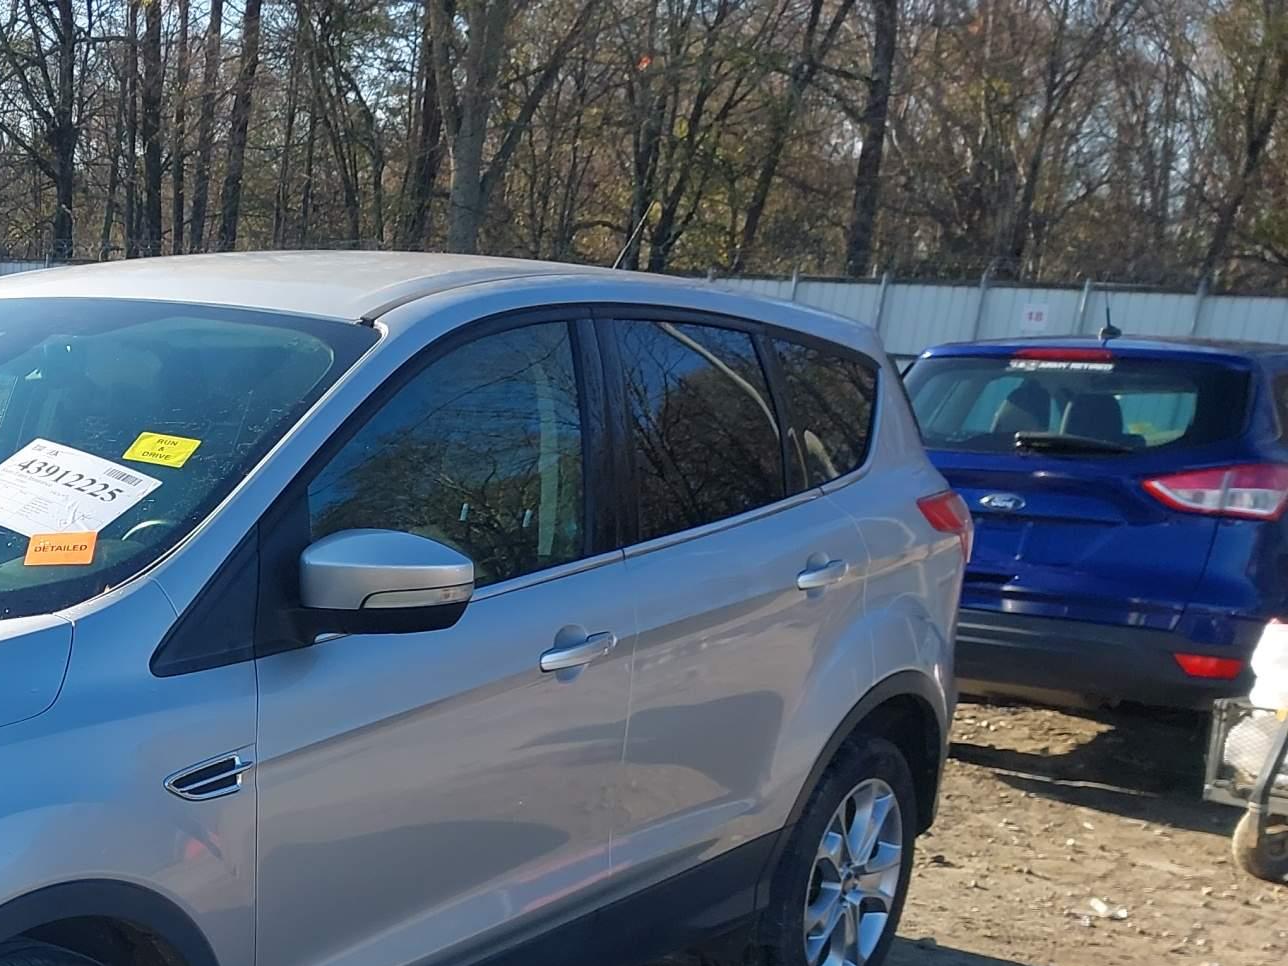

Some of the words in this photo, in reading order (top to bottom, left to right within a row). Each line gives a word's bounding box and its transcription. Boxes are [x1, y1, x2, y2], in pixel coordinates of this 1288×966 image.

[142, 451, 172, 460] DRIVE
[18, 459, 124, 502] 43912225
[34, 544, 88, 553] DETAILED
